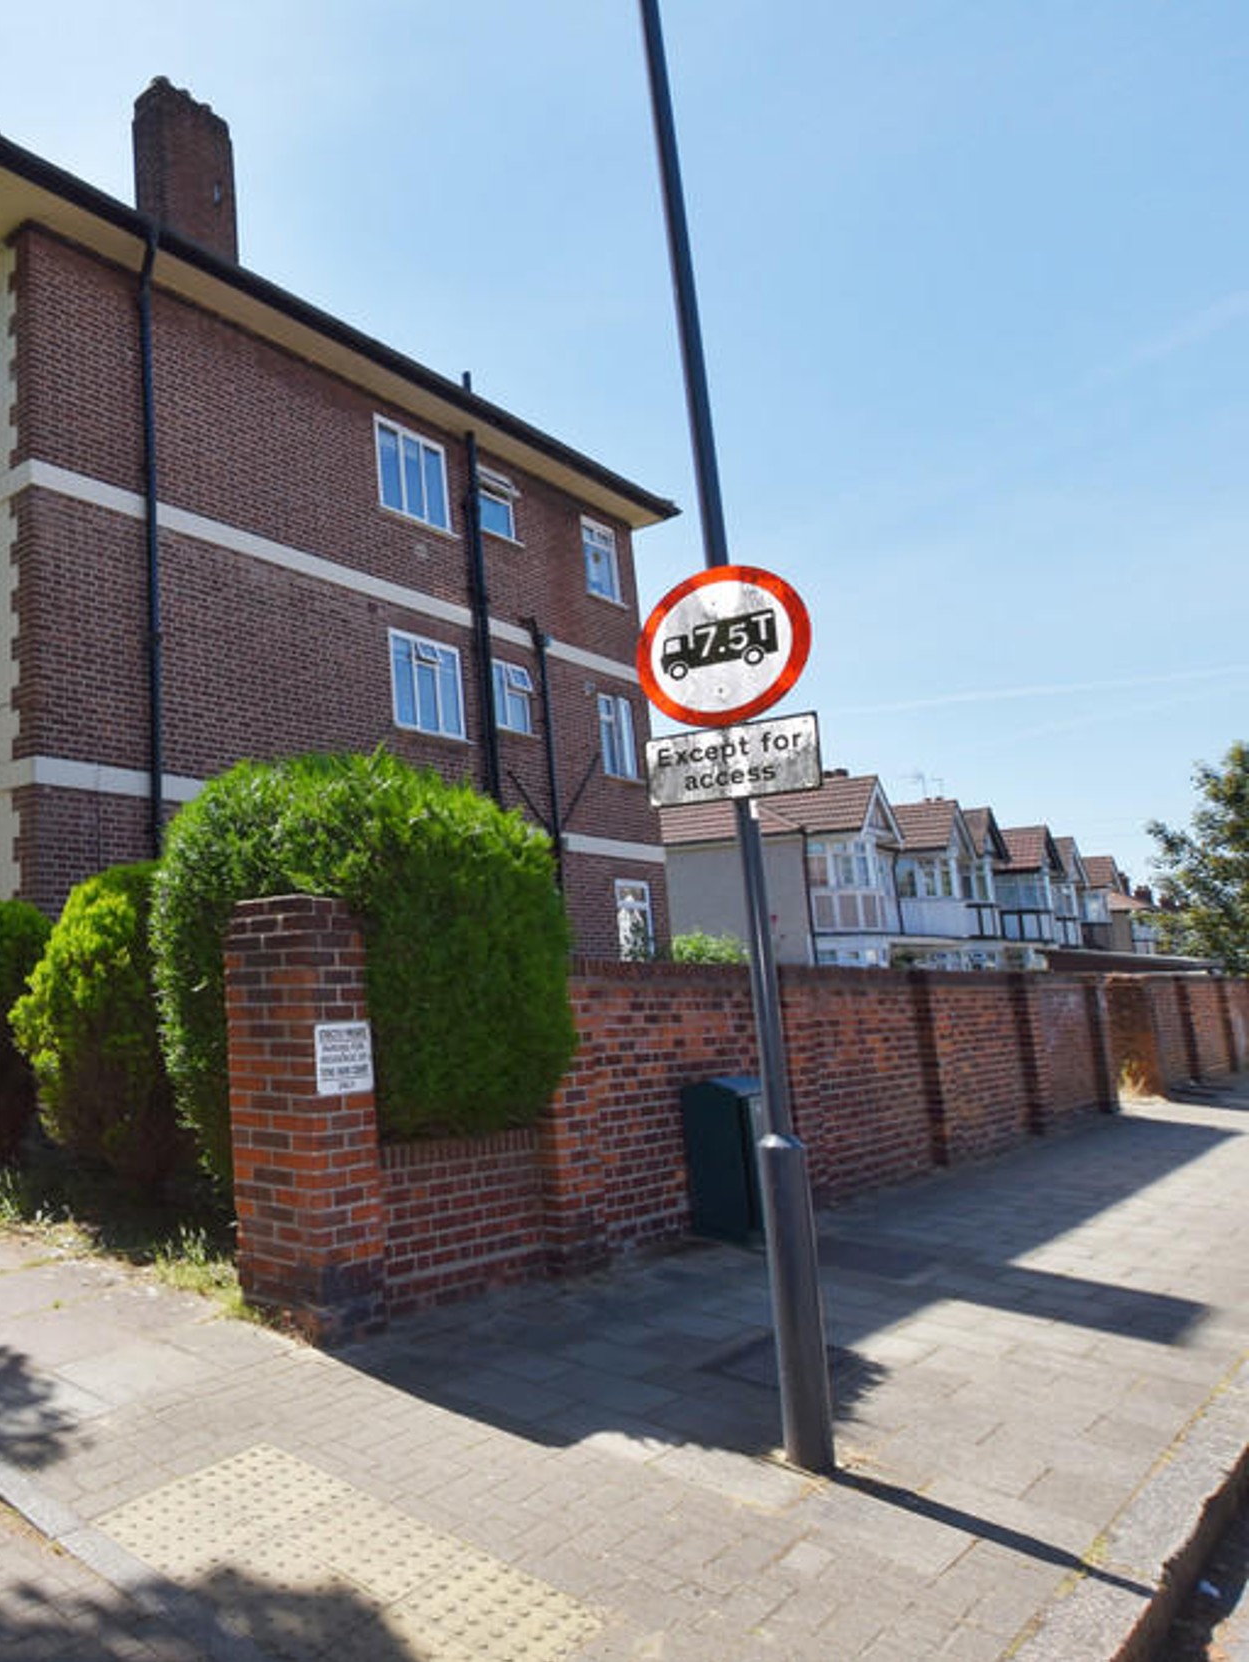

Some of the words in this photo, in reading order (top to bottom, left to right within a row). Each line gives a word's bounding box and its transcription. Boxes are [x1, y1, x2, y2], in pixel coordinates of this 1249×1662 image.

[695, 613, 772, 657] 7.5T
[657, 736, 749, 767] Except
[761, 732, 802, 752] for
[685, 765, 776, 791] access
